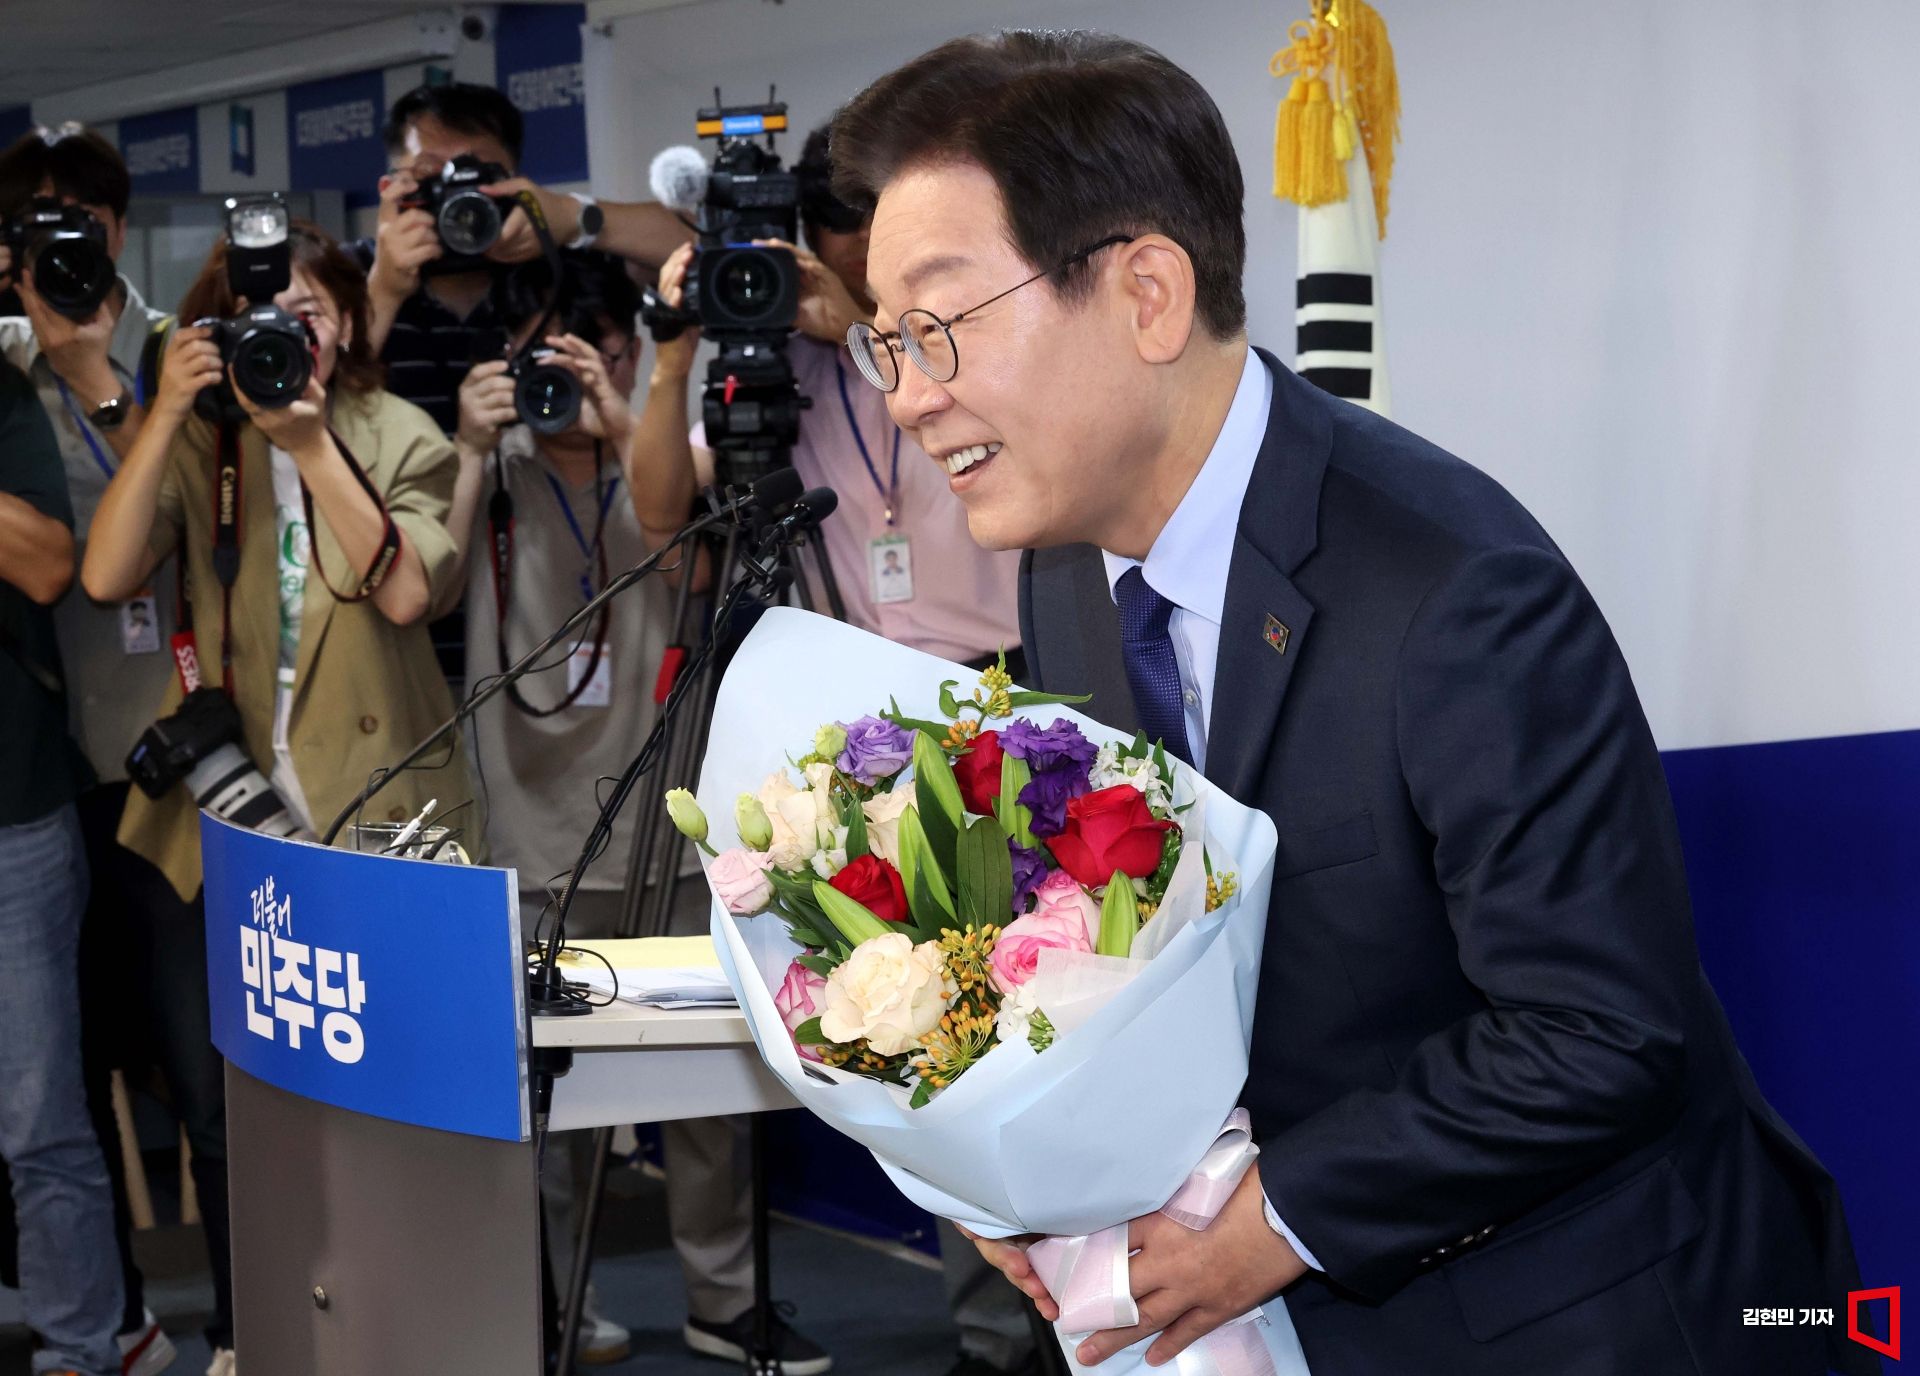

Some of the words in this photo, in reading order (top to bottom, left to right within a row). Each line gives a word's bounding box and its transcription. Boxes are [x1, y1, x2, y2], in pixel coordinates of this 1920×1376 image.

[221, 466, 236, 525] Canon
[176, 644, 202, 693] RESS
[250, 875, 292, 940] 더불어
[240, 925, 366, 1064] 민주당
